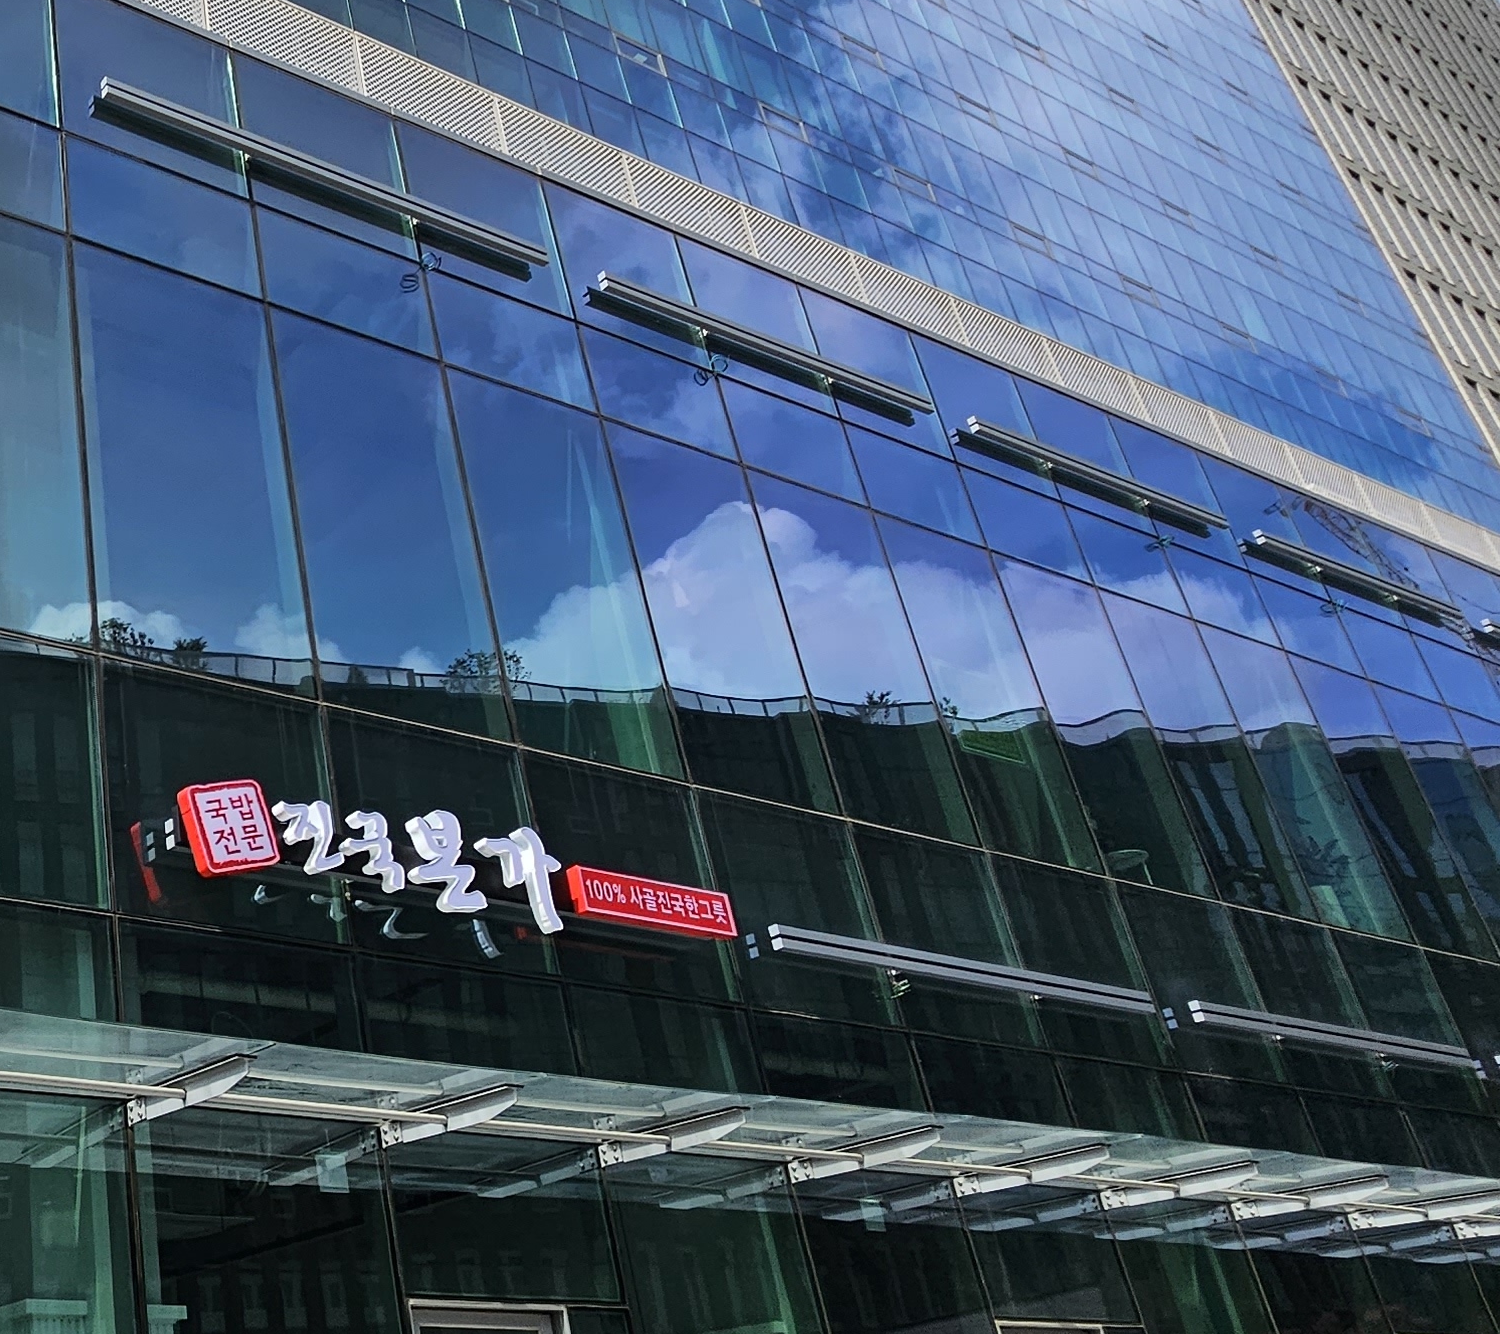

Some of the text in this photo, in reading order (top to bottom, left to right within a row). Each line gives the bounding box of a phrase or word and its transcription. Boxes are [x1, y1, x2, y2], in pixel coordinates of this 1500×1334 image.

[204, 793, 254, 825] 국밥
[212, 823, 265, 856] 전문
[271, 798, 564, 935] 진국본가
[584, 878, 728, 925] 100% 사골진국한그릇
